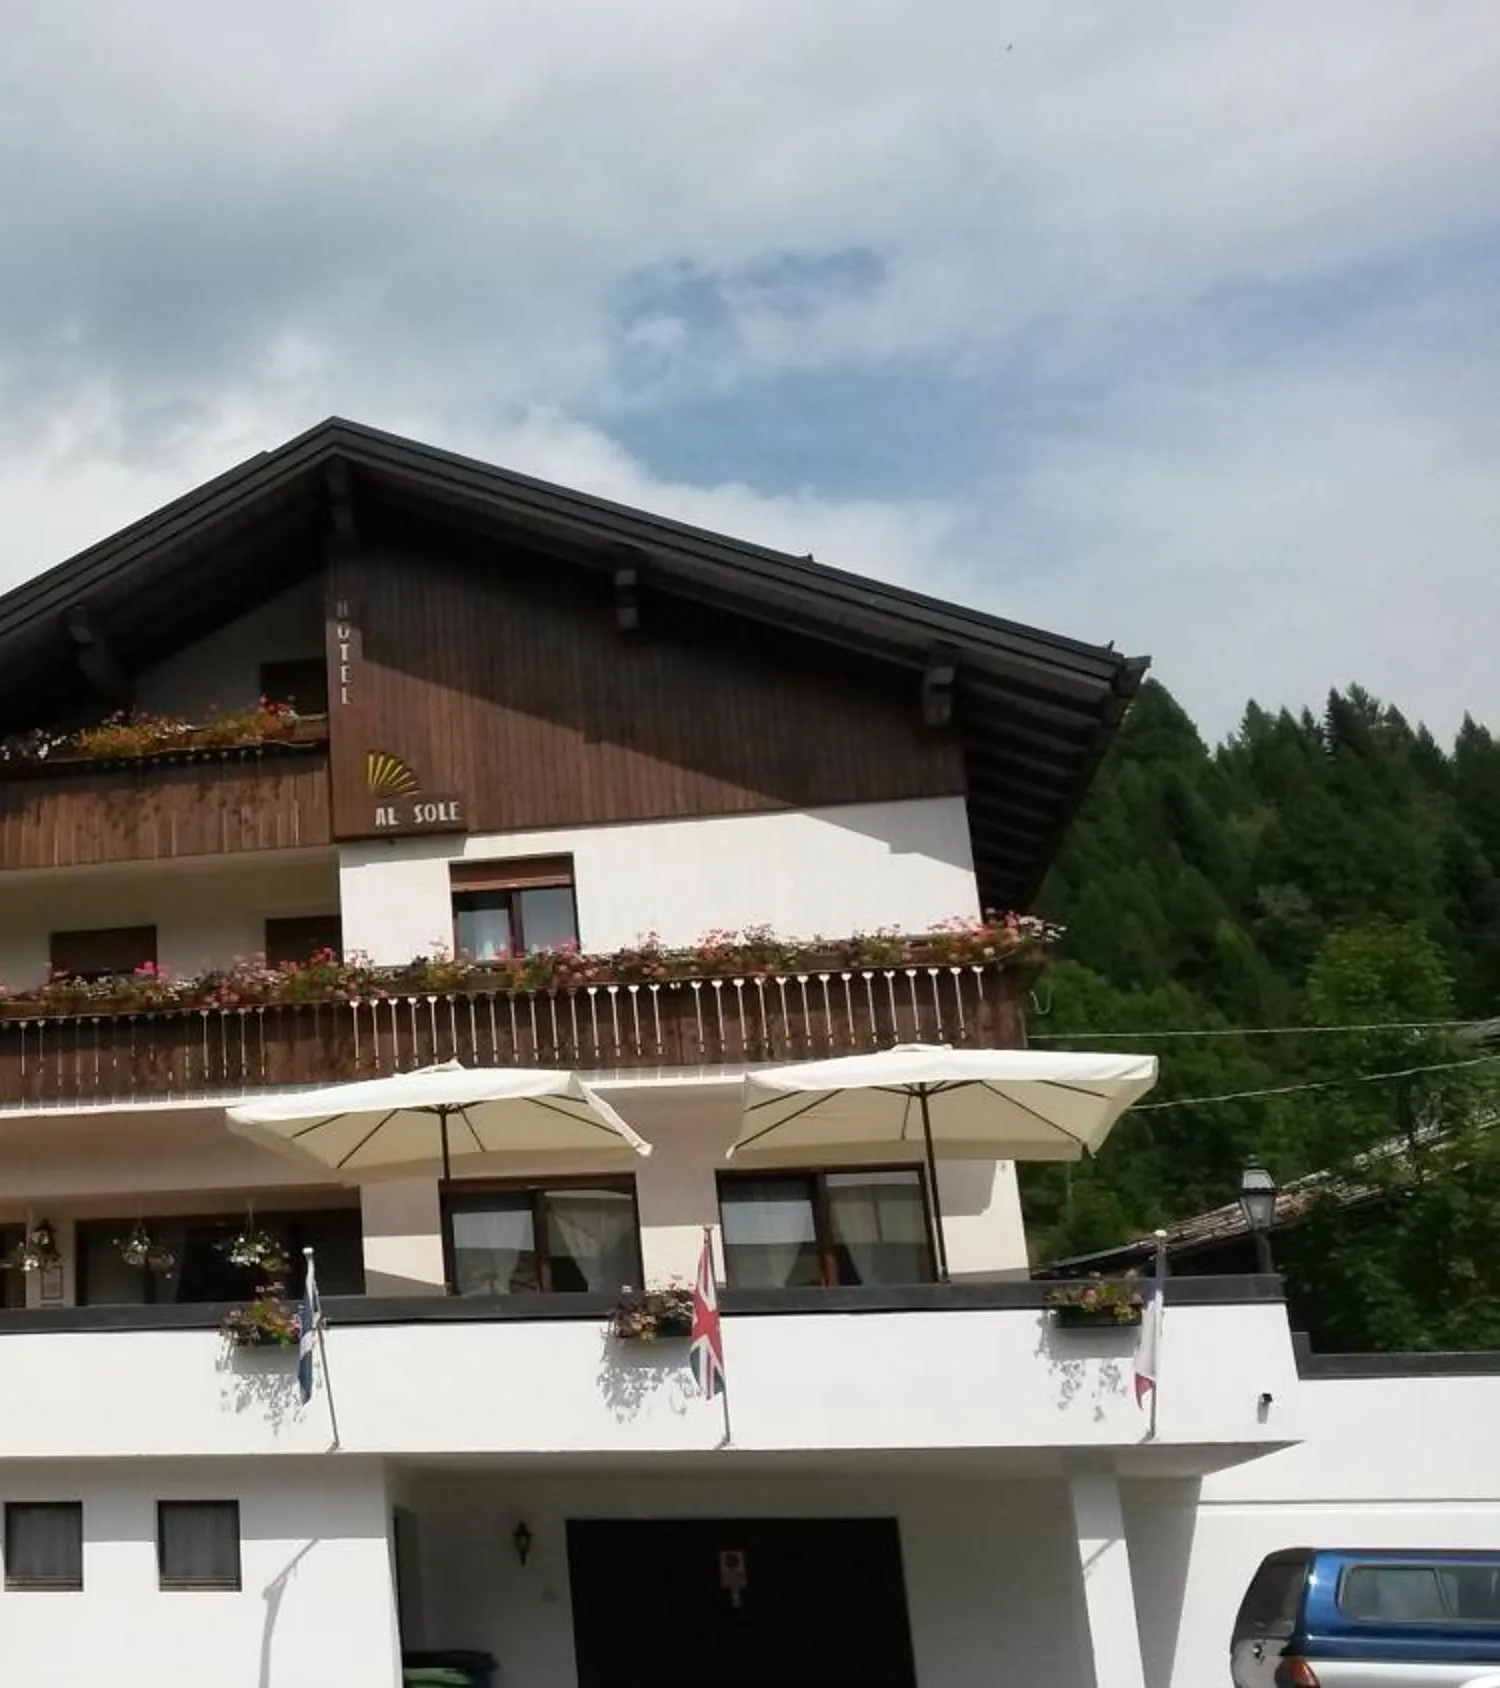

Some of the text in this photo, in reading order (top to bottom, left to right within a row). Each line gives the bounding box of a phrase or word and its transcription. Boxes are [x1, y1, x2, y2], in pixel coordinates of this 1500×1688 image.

[336, 598, 351, 704] HOTEL
[375, 801, 460, 826] AL SOLE
